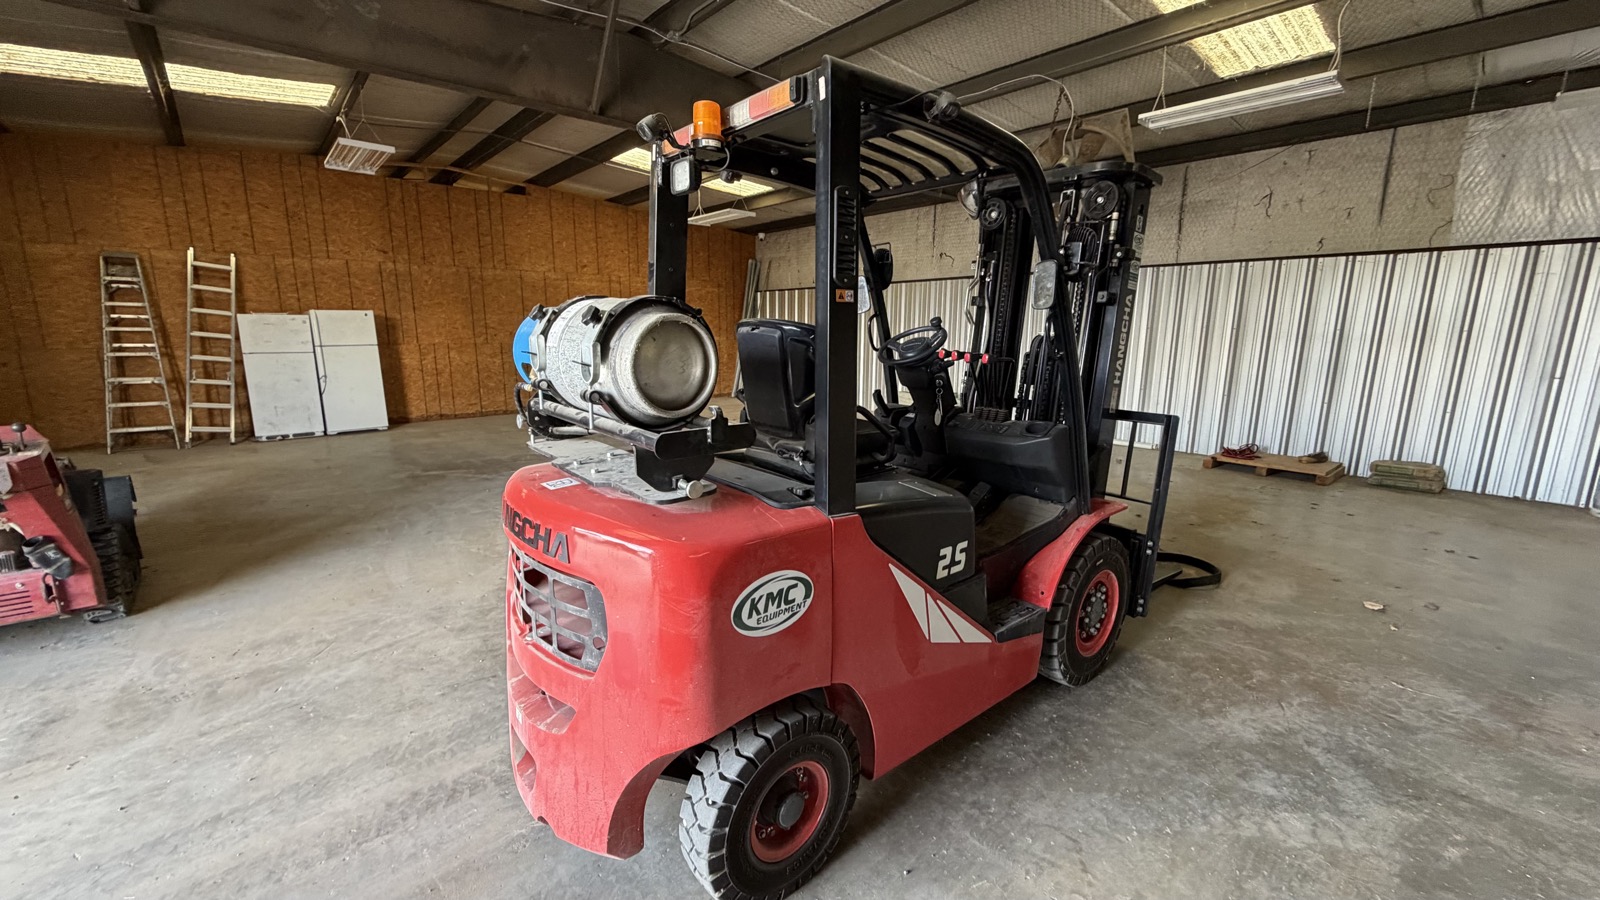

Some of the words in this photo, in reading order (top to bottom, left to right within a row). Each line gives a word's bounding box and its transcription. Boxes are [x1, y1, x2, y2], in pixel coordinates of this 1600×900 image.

[1113, 294, 1133, 385] HANGCHA
[504, 502, 571, 564] NGCHA
[936, 540, 968, 580] 25
[747, 583, 799, 620] KMC
[756, 600, 808, 626] EQUIPMENT
